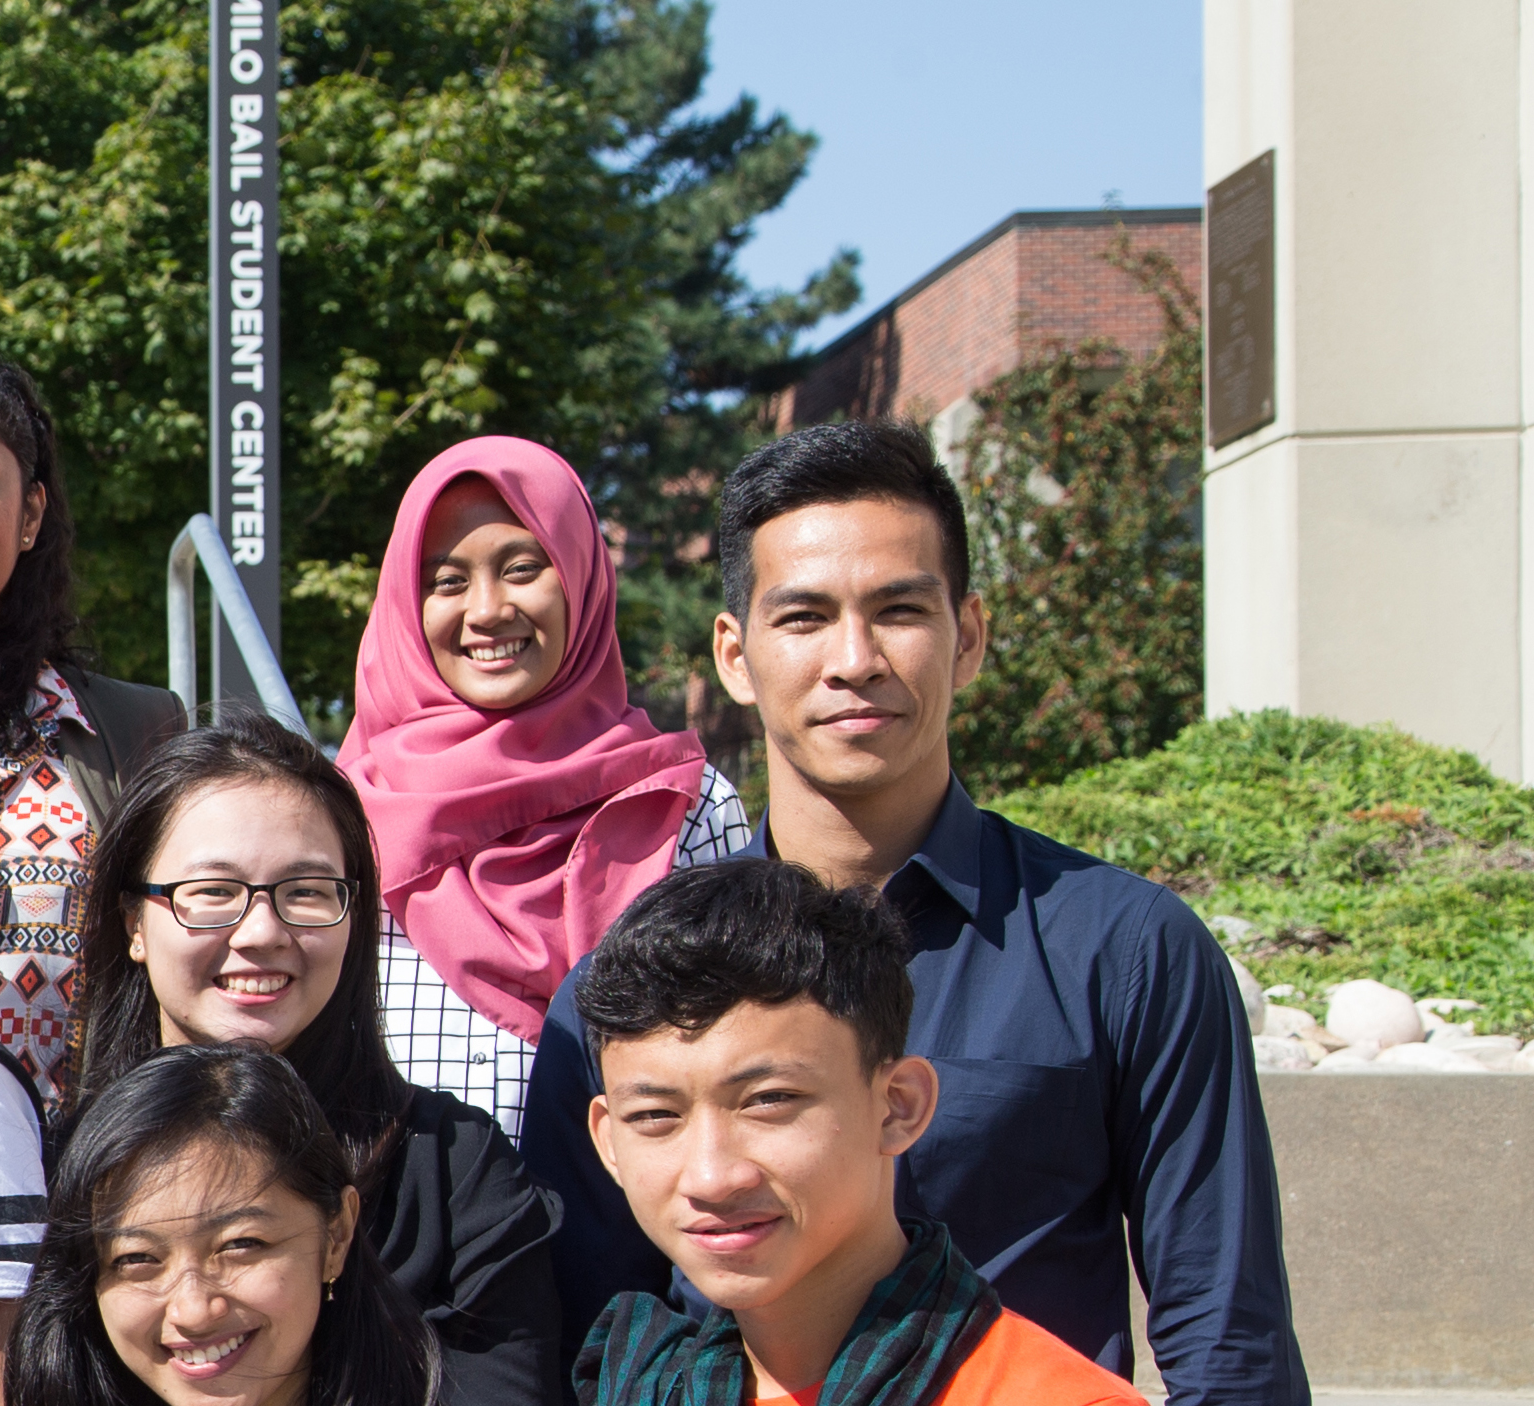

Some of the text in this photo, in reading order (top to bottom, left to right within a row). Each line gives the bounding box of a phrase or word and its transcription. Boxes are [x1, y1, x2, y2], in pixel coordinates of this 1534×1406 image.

[230, 94, 263, 191] BAIL
[230, 200, 264, 392] STUDENT
[231, 400, 265, 566] CENTER
